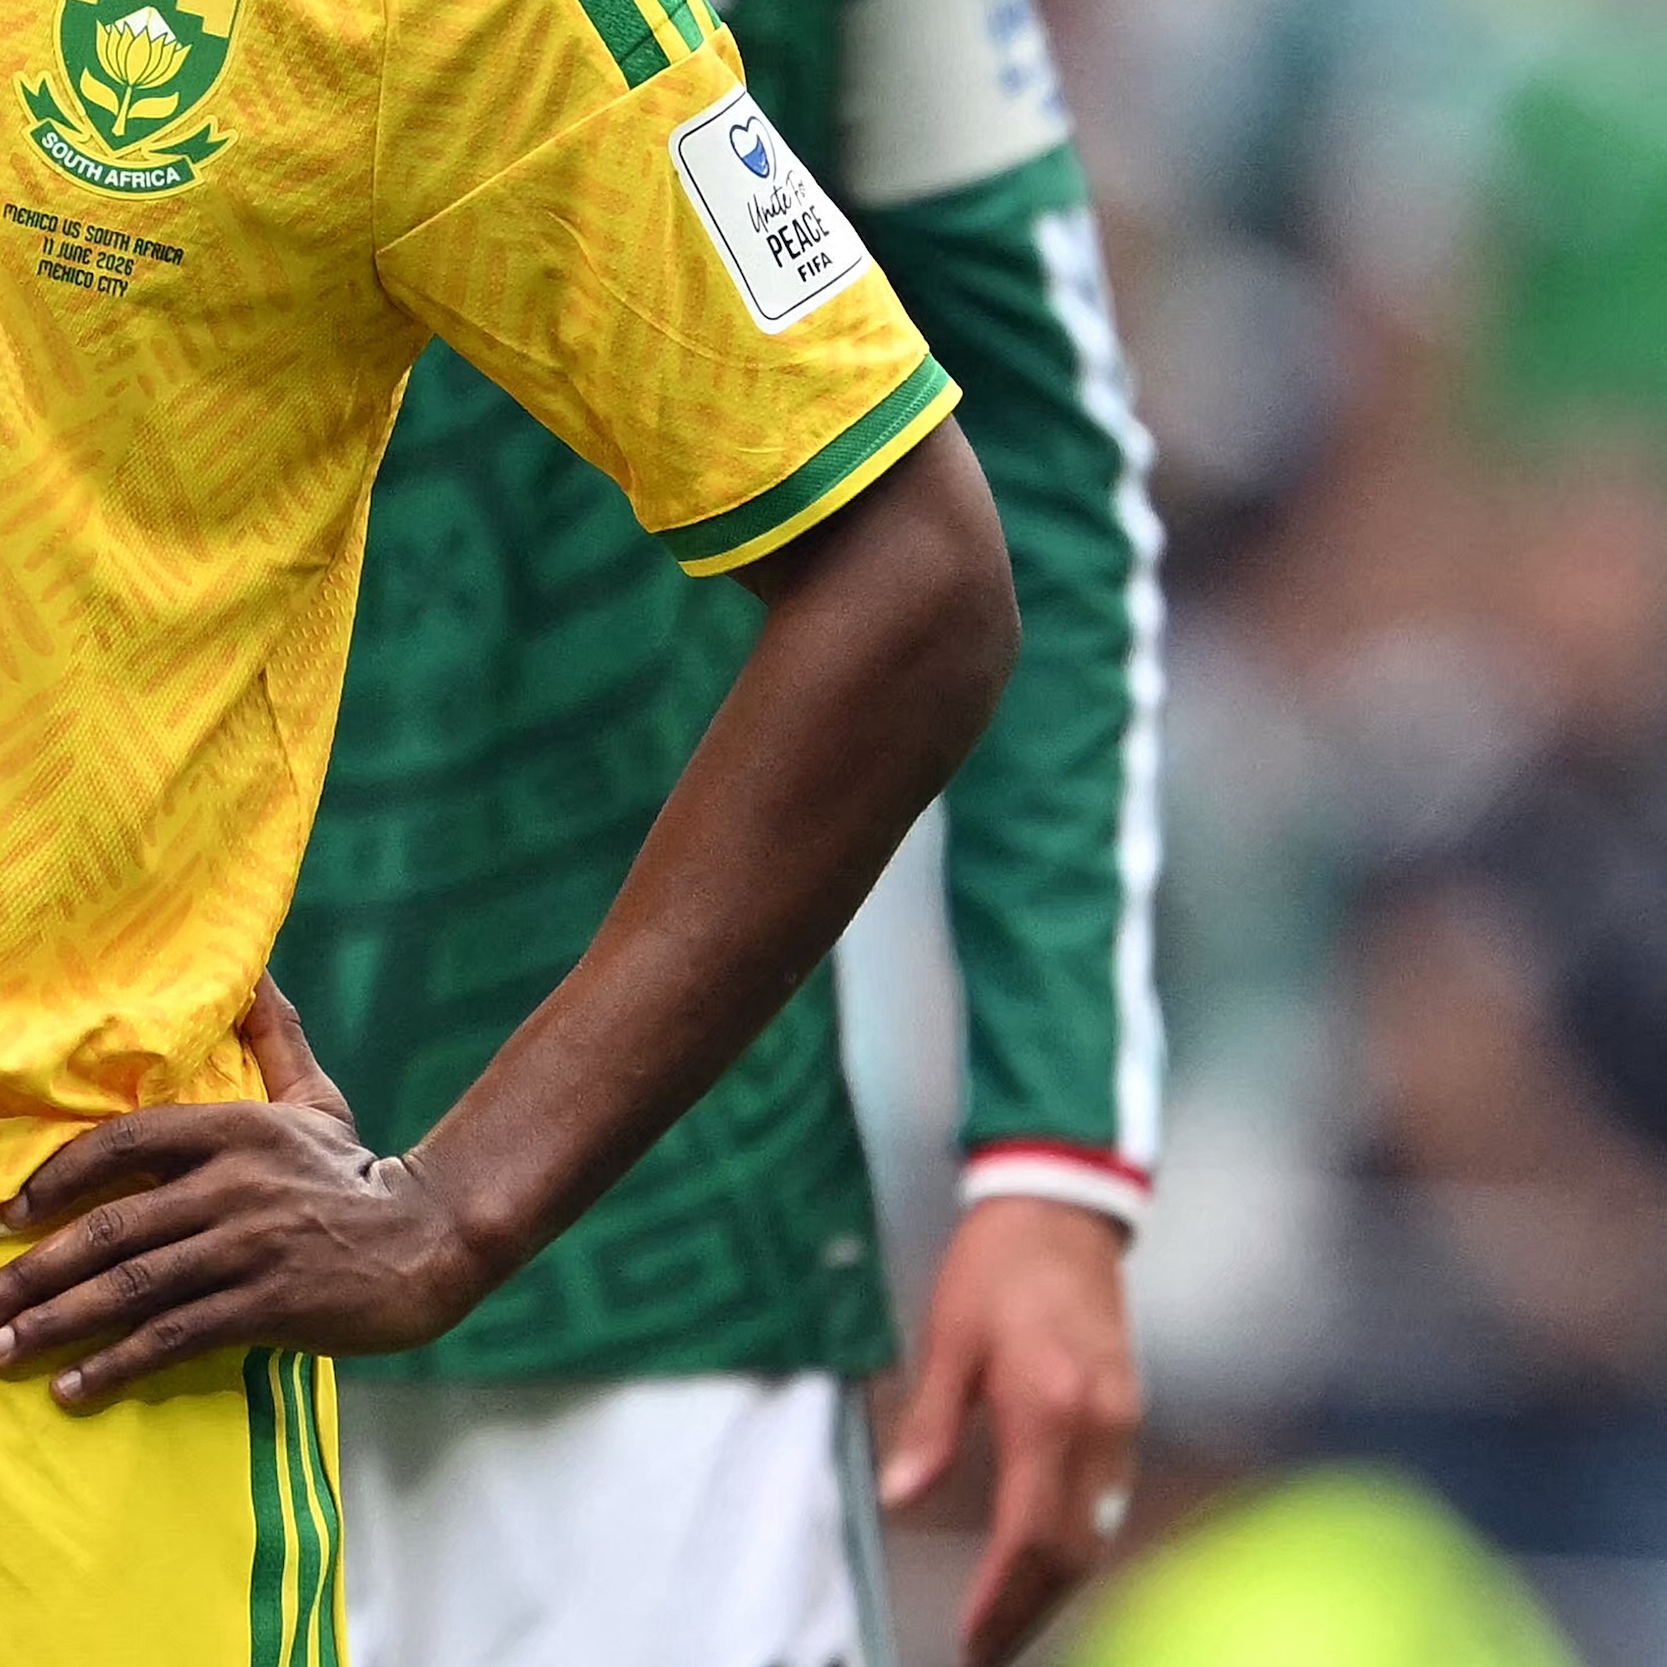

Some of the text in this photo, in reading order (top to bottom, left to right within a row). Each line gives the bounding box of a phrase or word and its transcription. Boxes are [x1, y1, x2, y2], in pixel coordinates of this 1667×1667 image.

[41, 131, 181, 189] SOUTH AFRICA
[747, 185, 792, 233] Unite
[3, 203, 59, 233] MEXICO
[85, 225, 131, 252] SOUTH
[133, 238, 185, 266] AFRICA
[42, 237, 135, 276] 11 JUNE 2026
[766, 205, 830, 268] PEACE
[36, 259, 129, 297] MEXICO CITY
[797, 252, 833, 282] FIFA
